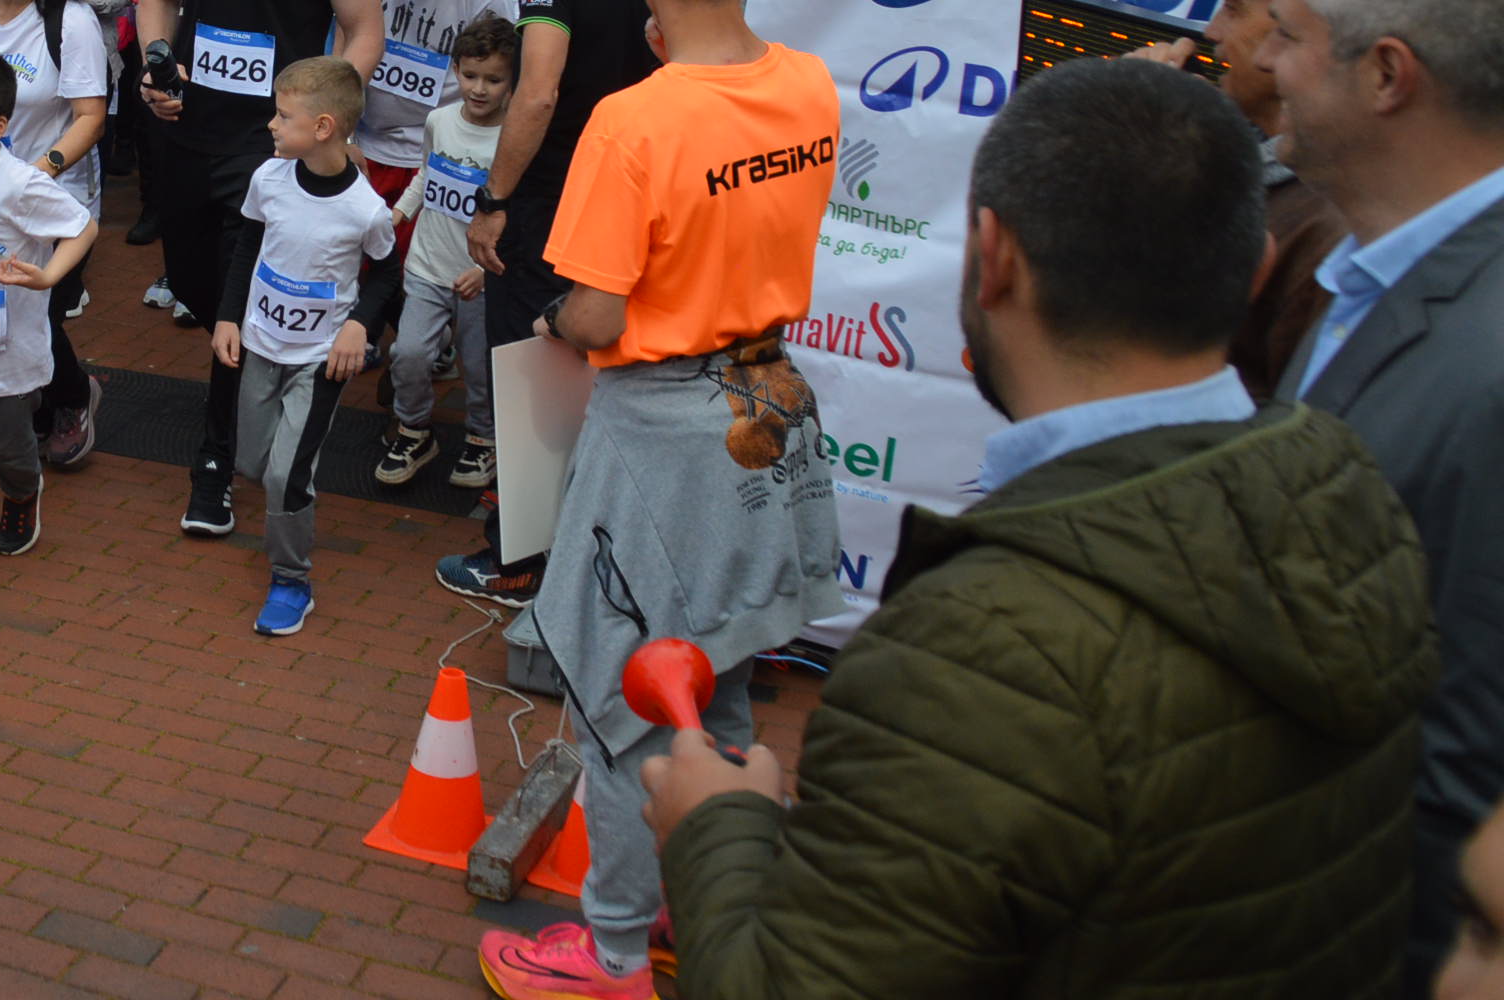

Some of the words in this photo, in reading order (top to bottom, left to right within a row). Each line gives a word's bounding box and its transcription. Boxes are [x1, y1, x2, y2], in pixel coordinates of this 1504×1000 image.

[197, 50, 267, 83] 4426
[372, 62, 436, 97] 5098
[425, 179, 478, 217] 5100
[258, 294, 327, 332] 4427
